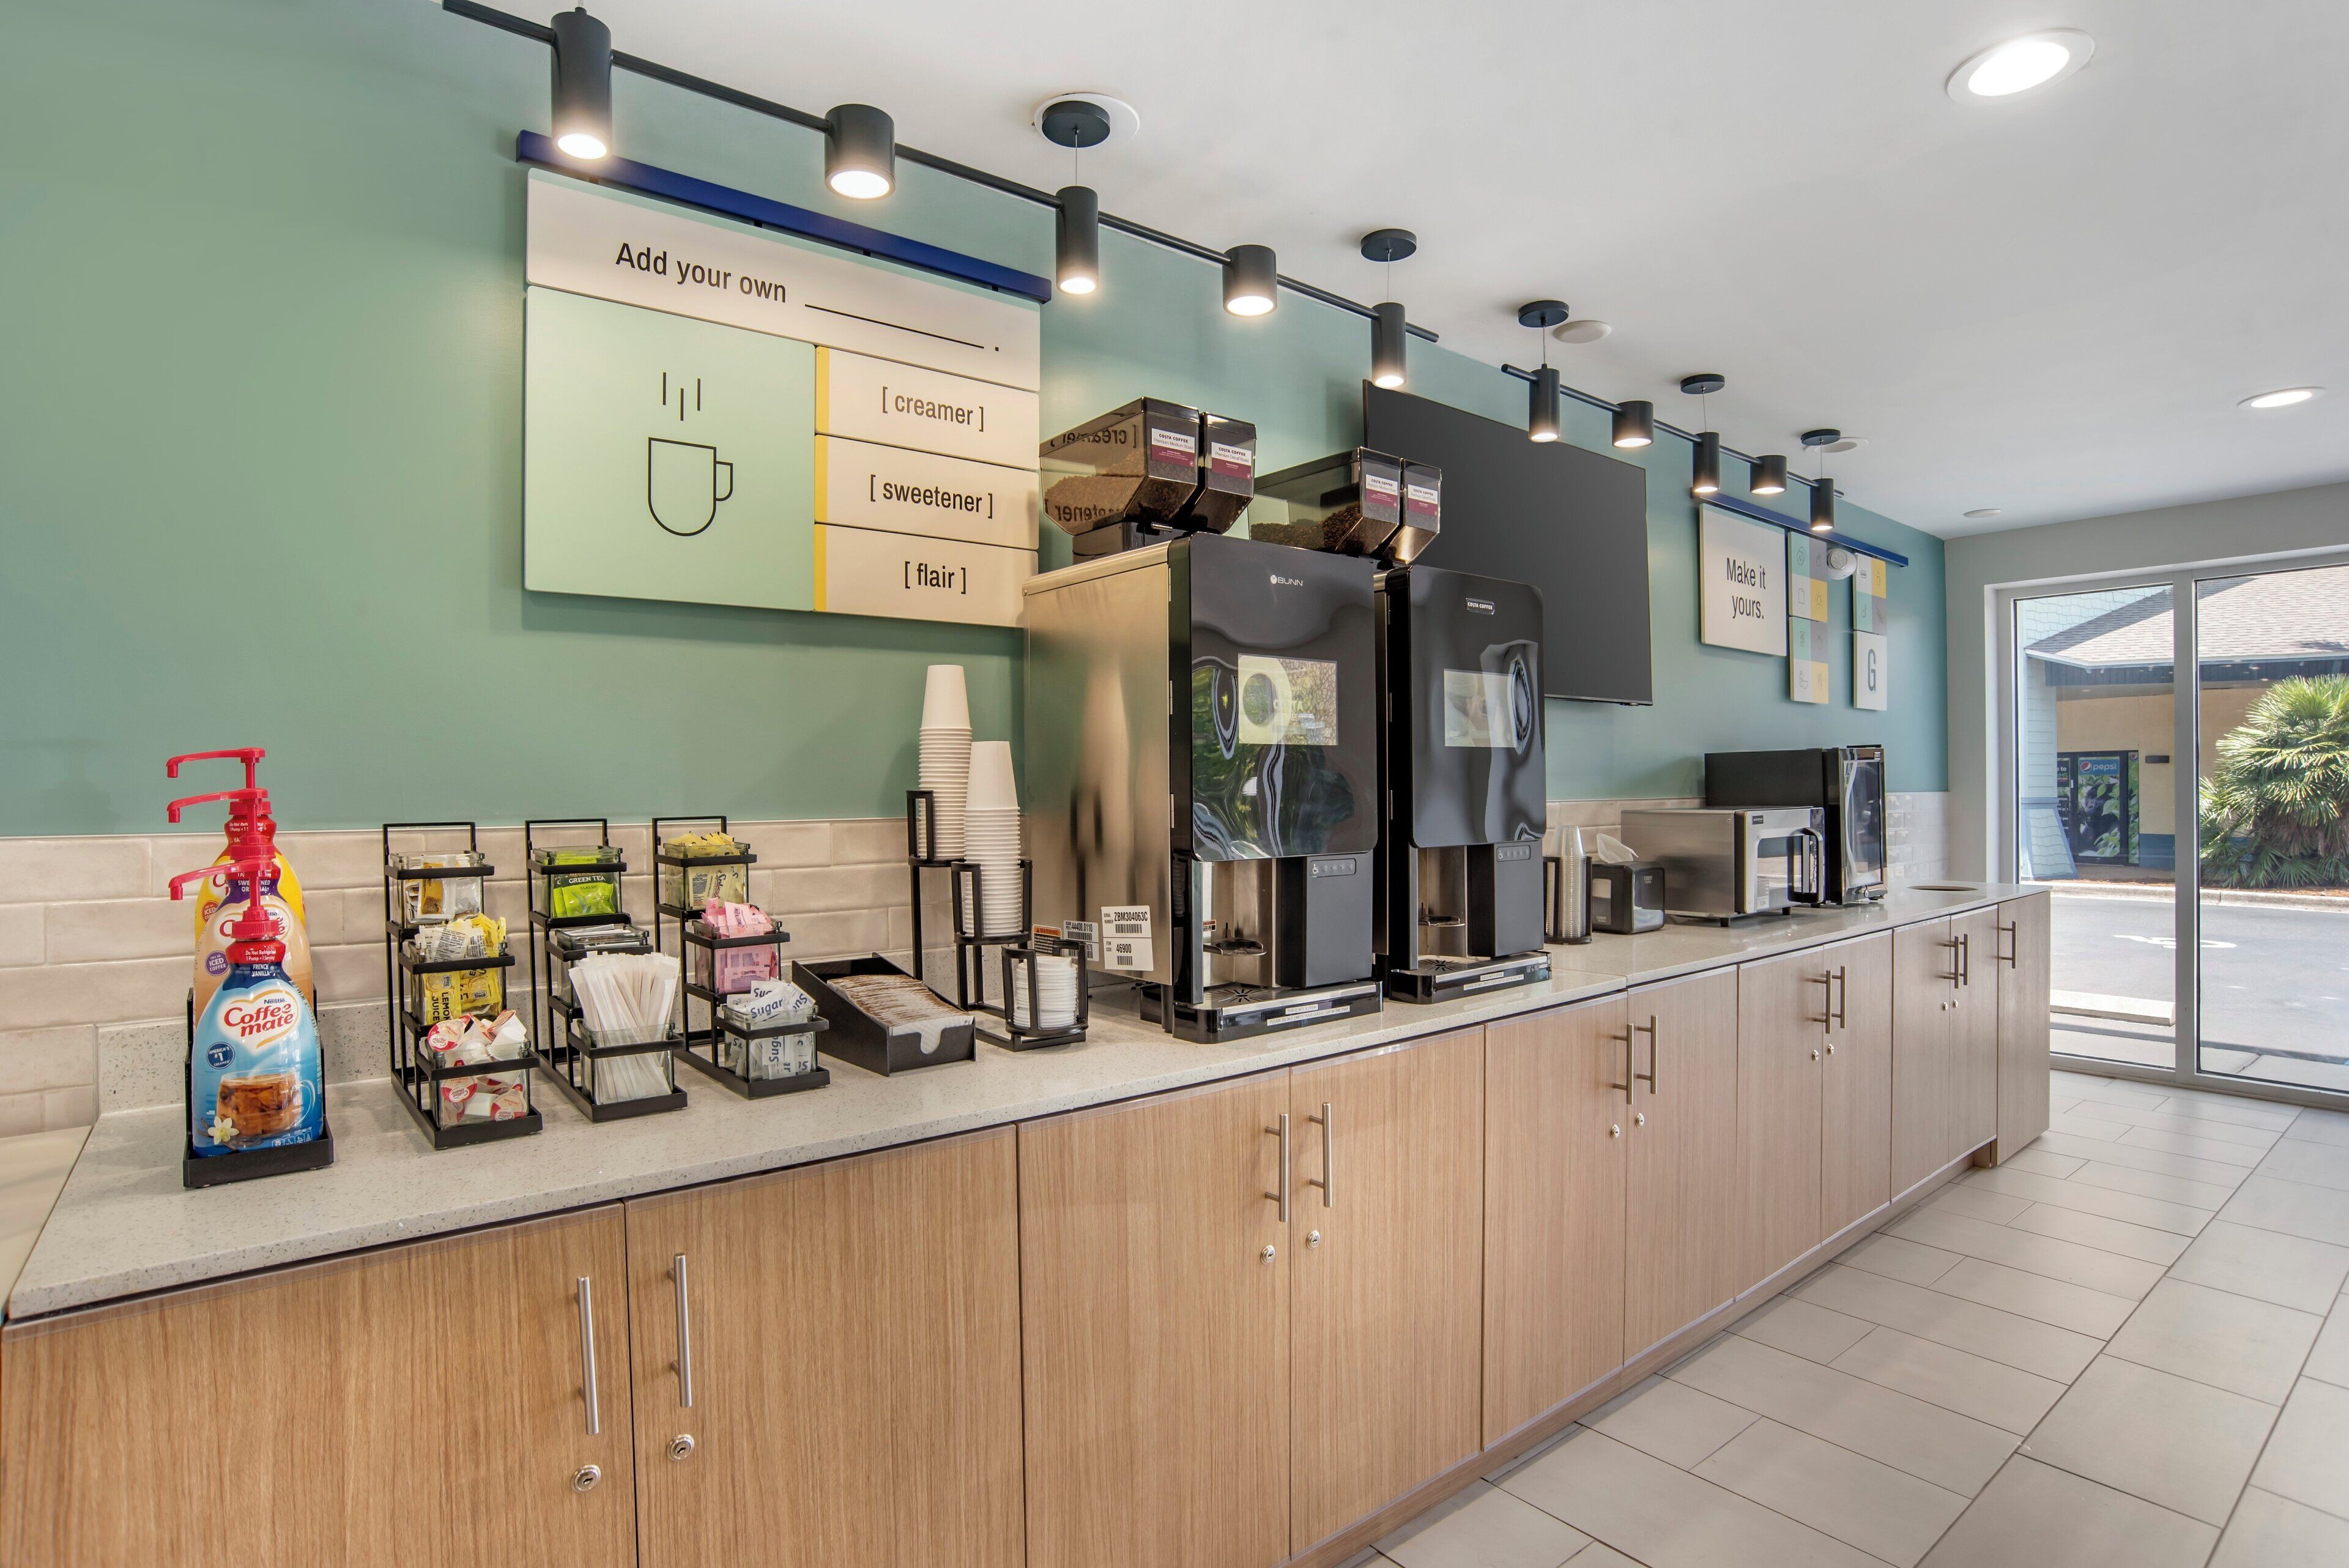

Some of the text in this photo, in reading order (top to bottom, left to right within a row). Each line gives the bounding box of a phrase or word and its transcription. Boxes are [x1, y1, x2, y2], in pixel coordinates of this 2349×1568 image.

[615, 242, 787, 304] Add your own
[1277, 576, 1303, 587] BUNN
[1727, 557, 1766, 590] Make it
[1732, 595, 1765, 620] yours.
[1867, 648, 1877, 692] G
[2093, 762, 2117, 771] pepsi
[1072, 922, 1093, 932] 44400.0110
[1114, 911, 1148, 922] ZBM304063C
[1116, 943, 1132, 953] 46900
[209, 957, 225, 967] ICED
[224, 1003, 292, 1027] Coffee
[431, 995, 440, 1022] JUICE
[441, 992, 450, 1021] LEMON
[750, 998, 783, 1019] Sugar
[240, 1013, 294, 1038] mate
[209, 1046, 230, 1055] AMERICA'S
